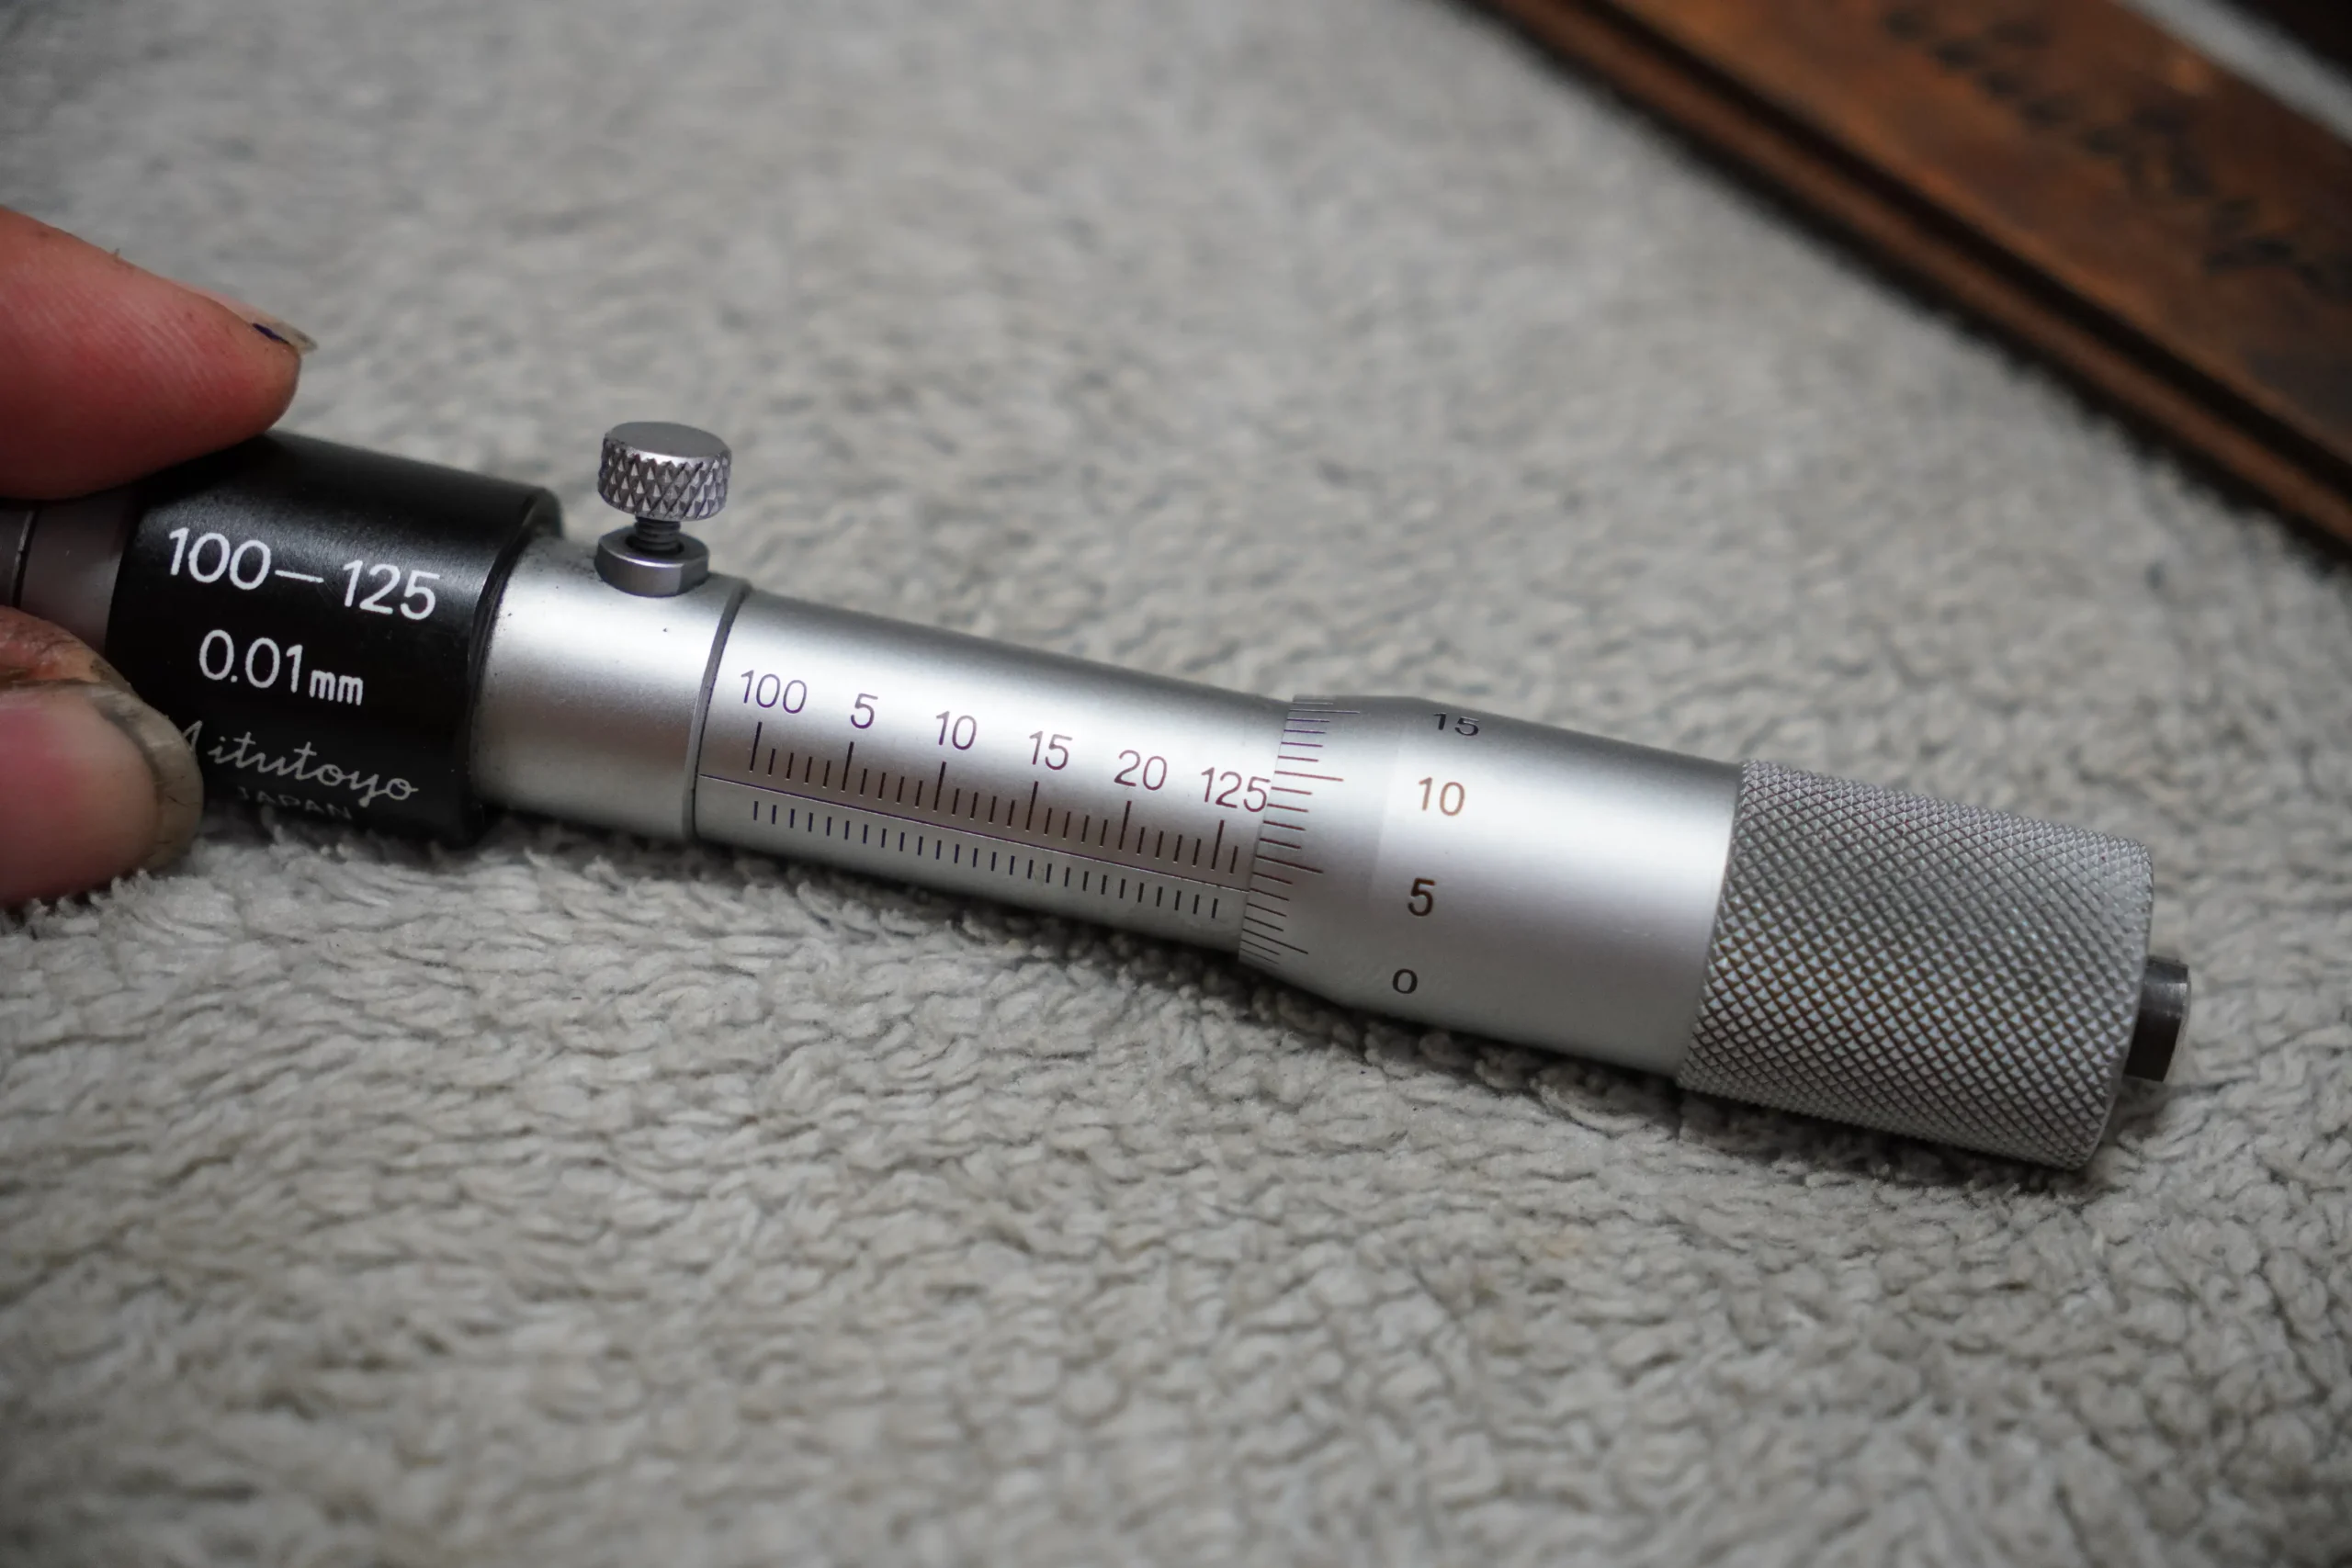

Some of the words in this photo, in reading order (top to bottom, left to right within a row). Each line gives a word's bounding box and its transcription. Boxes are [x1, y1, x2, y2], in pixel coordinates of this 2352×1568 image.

[740, 670, 808, 715] 100
[850, 693, 878, 729] 5
[935, 710, 978, 751] 10
[1028, 730, 1074, 771] 15
[1113, 750, 1169, 792] 20
[1201, 766, 1272, 813] 125
[1432, 712, 1480, 737] 15
[1418, 776, 1466, 817] 10
[1407, 877, 1436, 917] 5
[1391, 967, 1419, 995] 0
